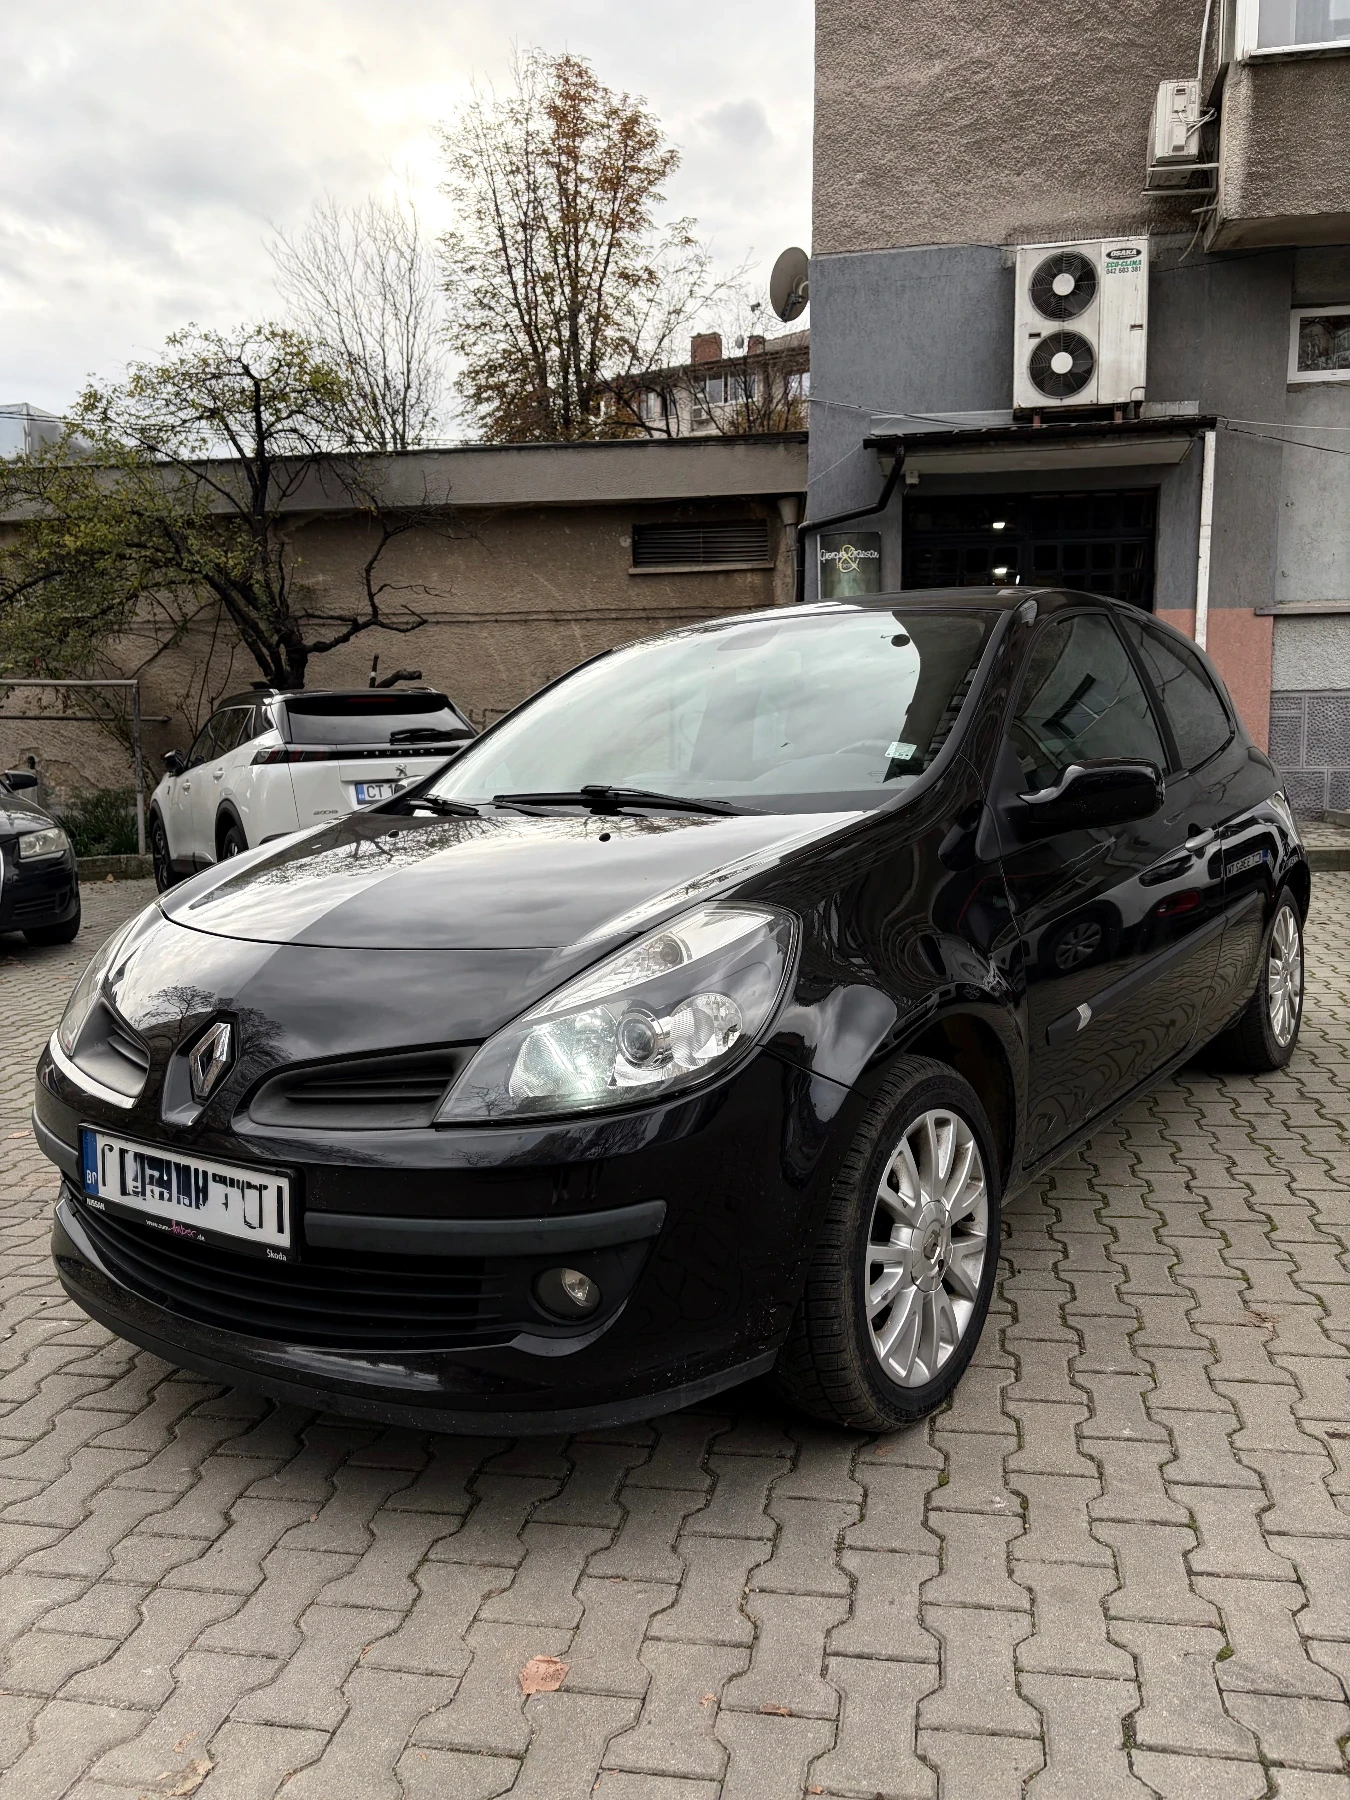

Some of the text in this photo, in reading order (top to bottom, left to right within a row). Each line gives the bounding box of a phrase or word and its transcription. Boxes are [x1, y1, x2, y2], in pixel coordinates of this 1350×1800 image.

[1105, 260, 1141, 268] ECO-CLIMA
[366, 783, 384, 798] CT
[86, 1197, 106, 1211] NISSAN
[266, 1248, 287, 1261] Škoda
